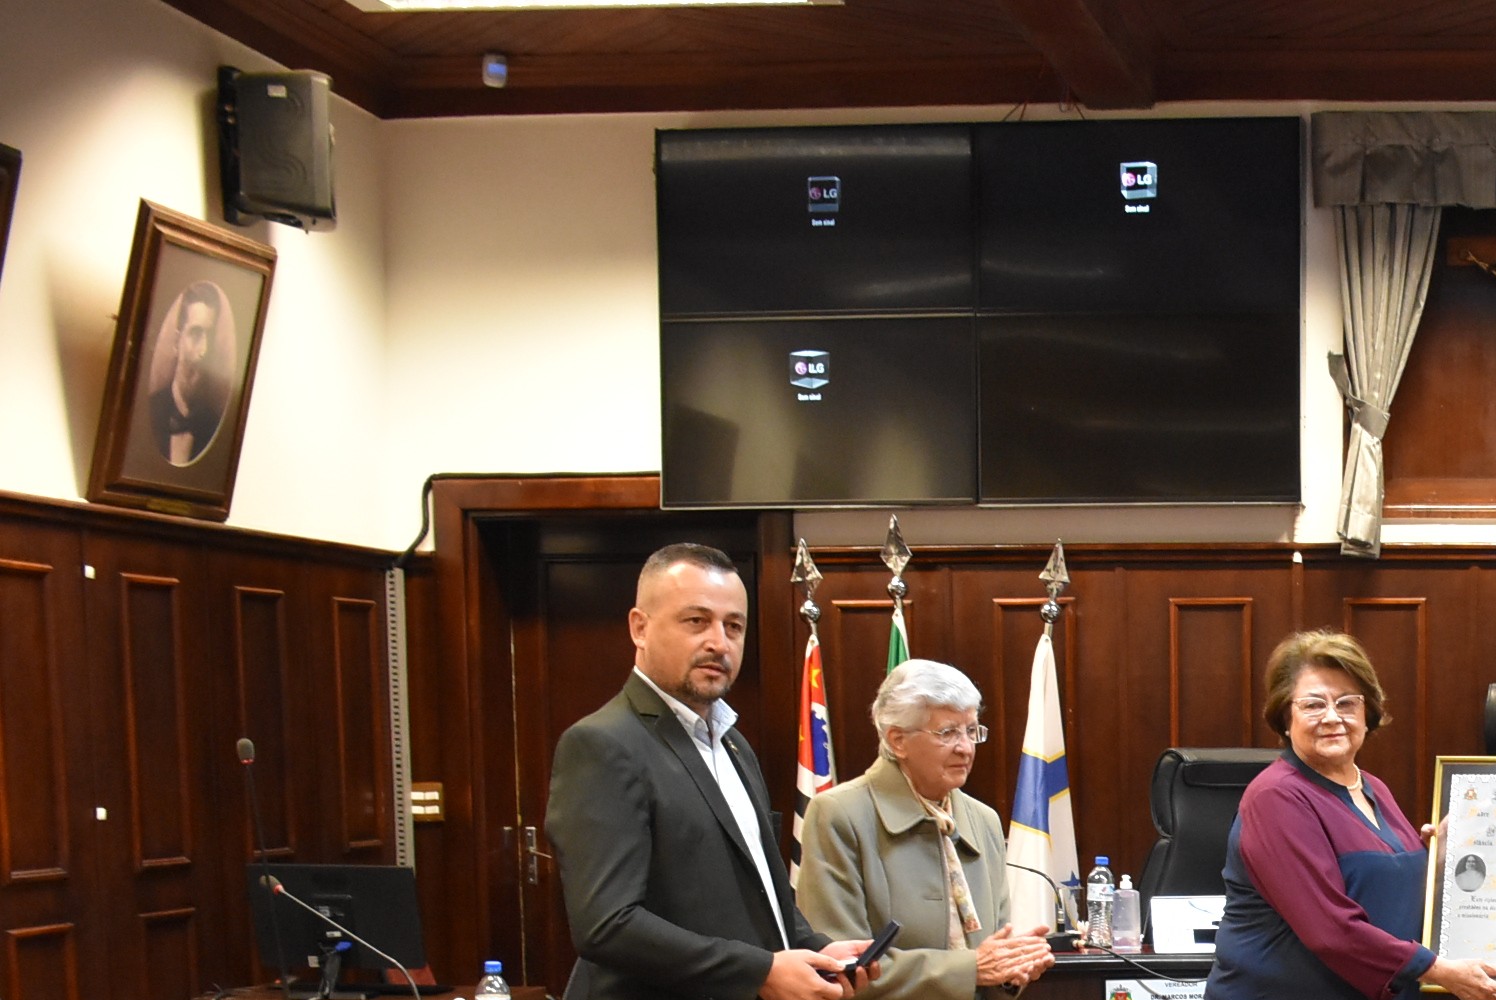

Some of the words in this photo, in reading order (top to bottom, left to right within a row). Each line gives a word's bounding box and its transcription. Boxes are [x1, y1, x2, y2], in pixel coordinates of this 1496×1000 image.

[1137, 174, 1152, 185] LG
[823, 188, 838, 199] LG
[1162, 993, 1187, 1000] MARCOS
